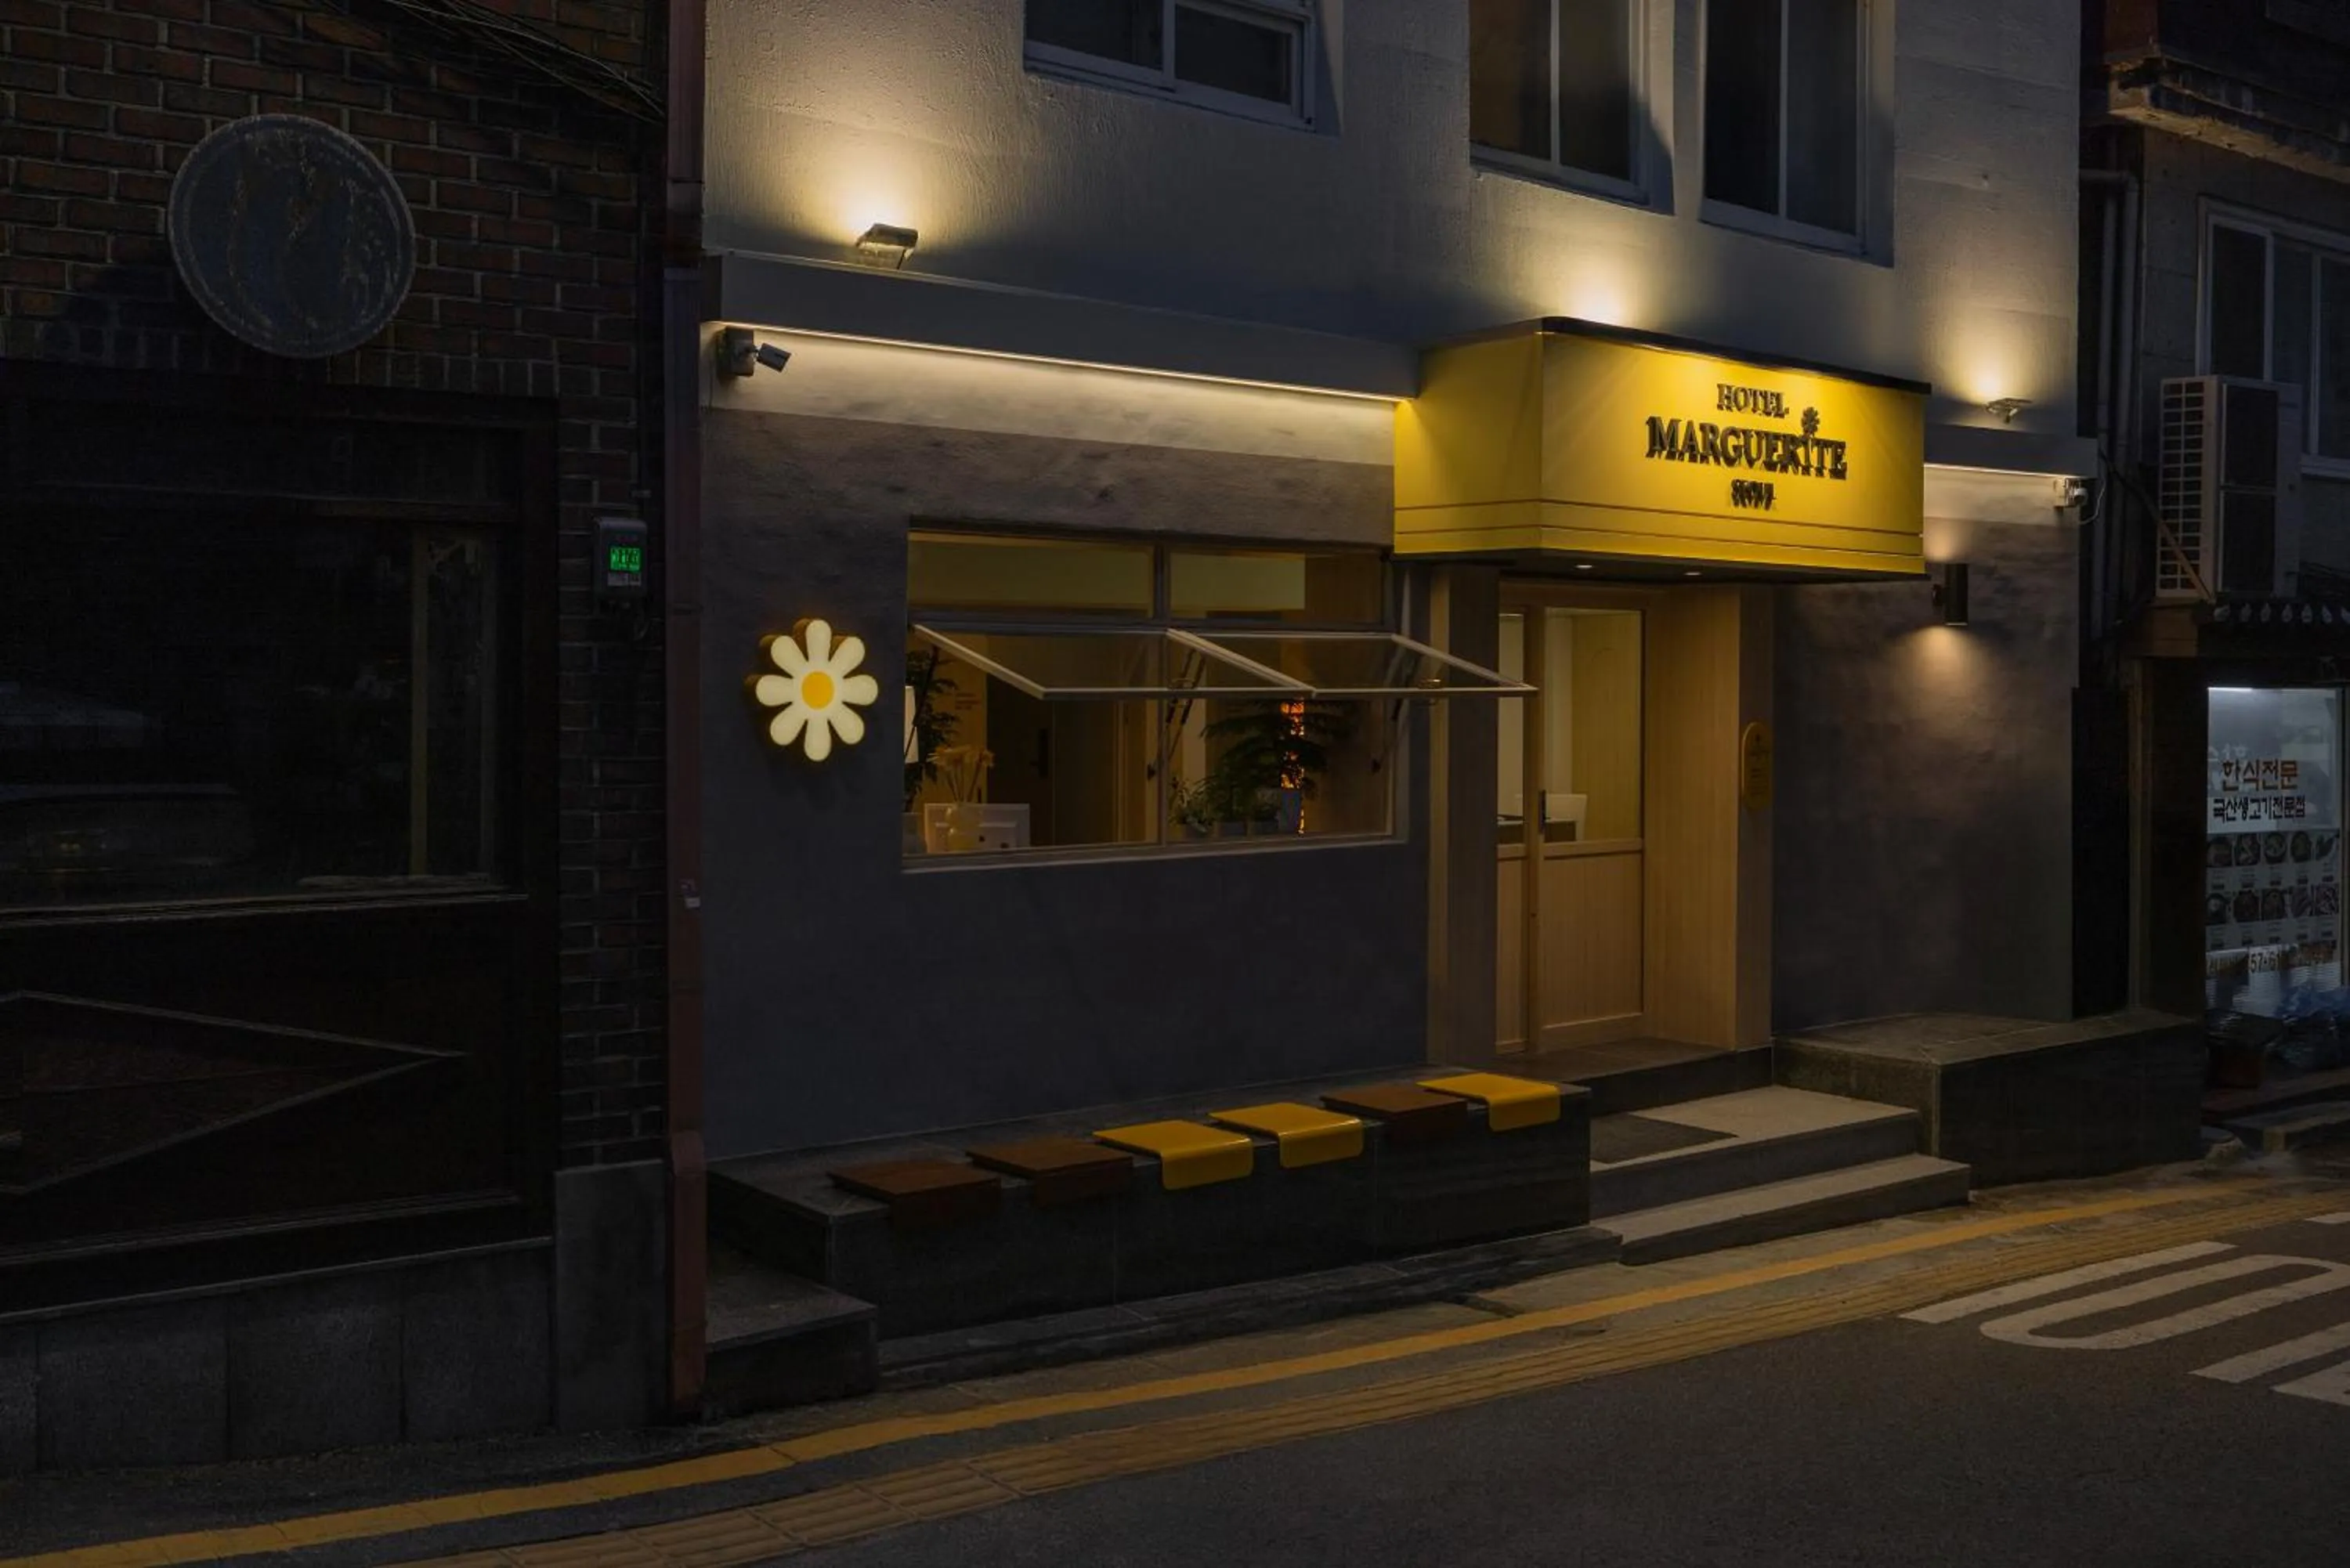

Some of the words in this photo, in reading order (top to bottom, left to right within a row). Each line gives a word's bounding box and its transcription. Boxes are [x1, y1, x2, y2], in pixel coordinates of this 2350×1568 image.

[1716, 384, 1790, 418] HOTEL
[1646, 416, 1847, 480] MARGUERITE
[2222, 758, 2298, 791] 한식전문
